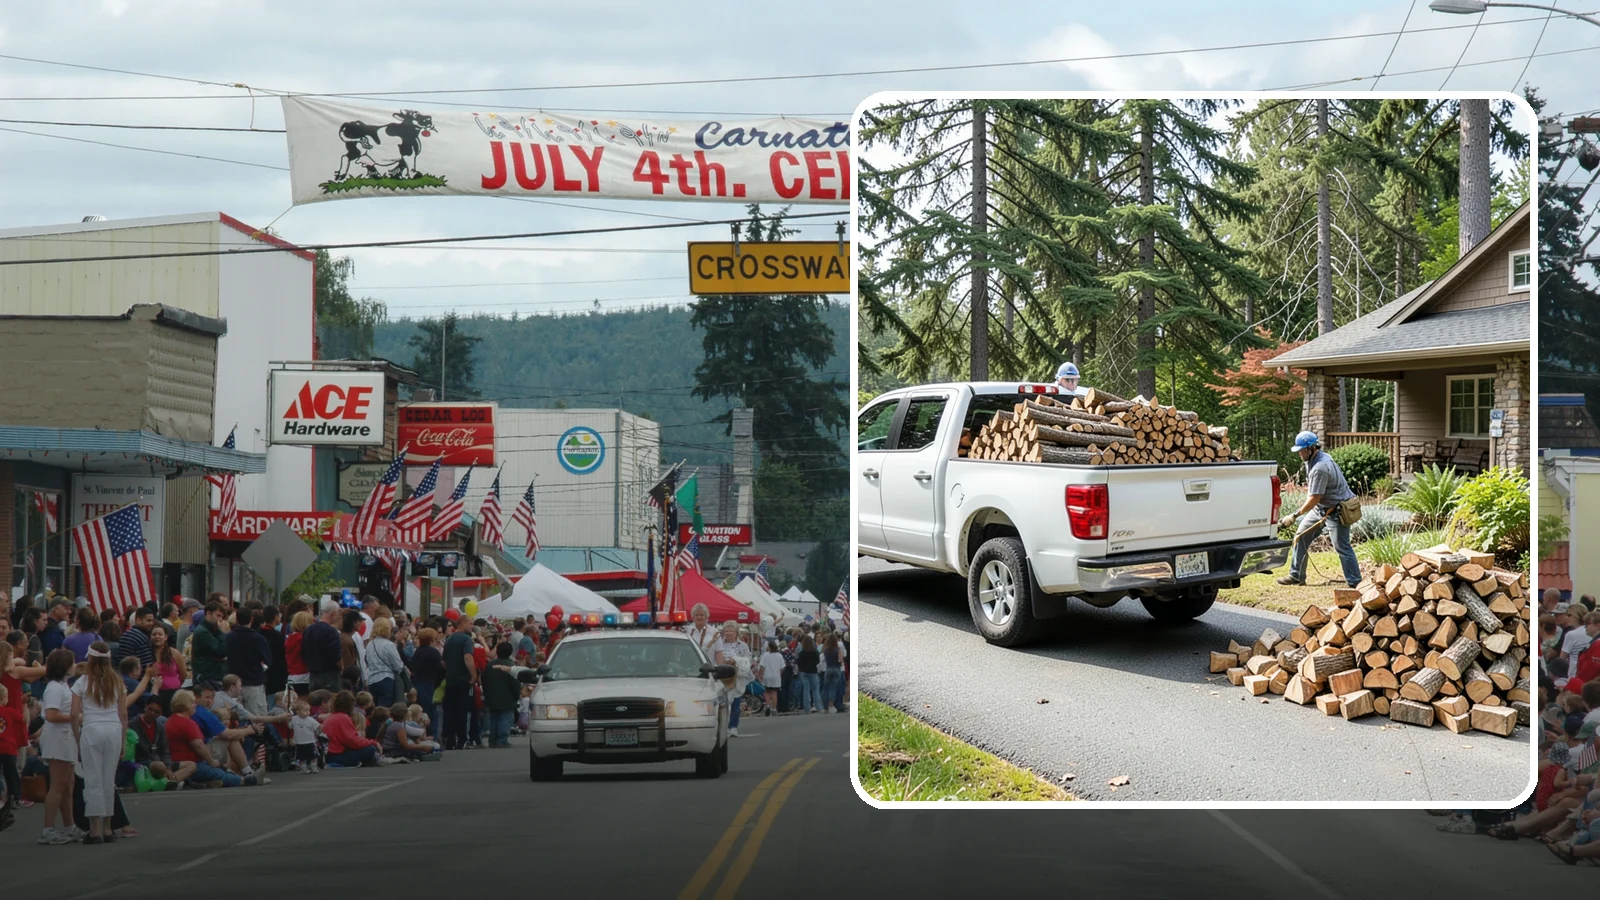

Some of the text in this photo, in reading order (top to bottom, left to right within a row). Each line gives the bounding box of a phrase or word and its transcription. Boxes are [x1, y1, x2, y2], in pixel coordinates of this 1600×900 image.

[481, 140, 605, 192] JULY
[632, 149, 746, 198] 4th.
[697, 254, 850, 280] CROSSWA
[283, 380, 373, 420] ACE
[406, 409, 452, 422] CEDAR
[283, 421, 371, 437] Hardware
[416, 428, 477, 447] Coca-Cola
[354, 467, 387, 480] Simpl
[83, 485, 155, 495] St. Vincent de Paul
[688, 526, 741, 535] CRNATION
[699, 535, 730, 543] GLASS
